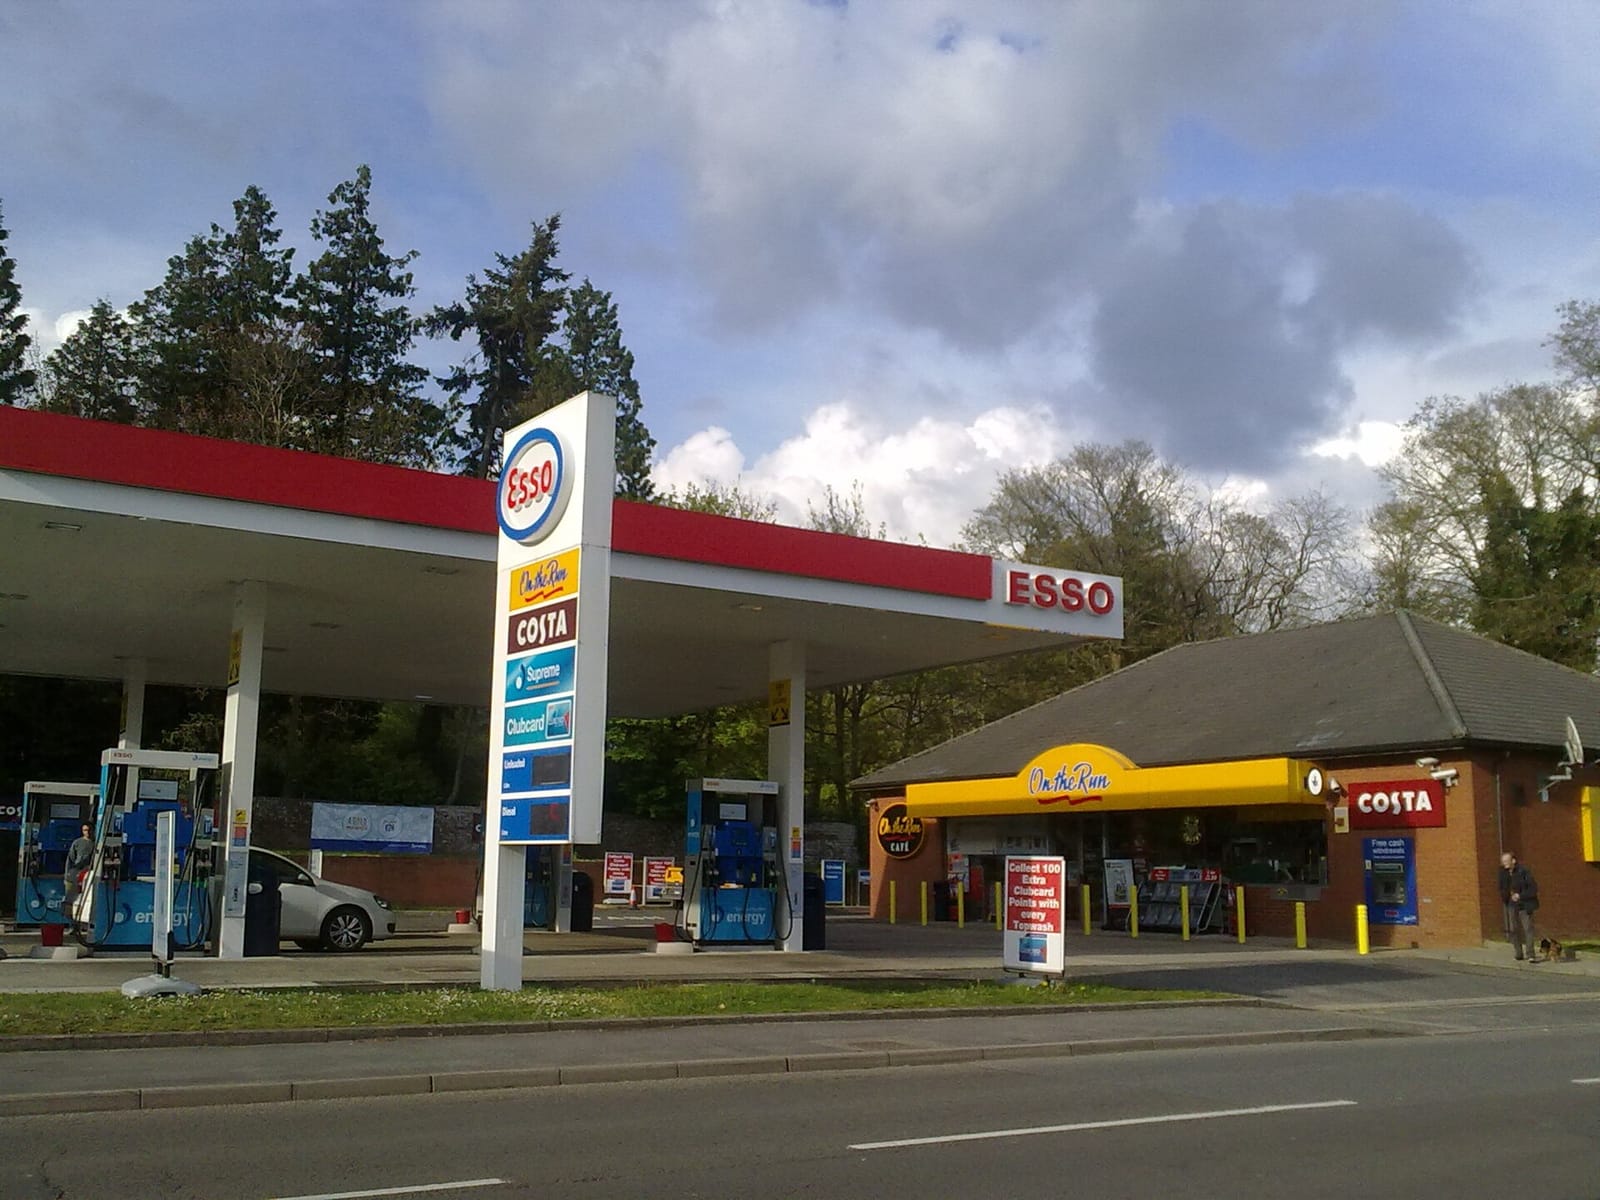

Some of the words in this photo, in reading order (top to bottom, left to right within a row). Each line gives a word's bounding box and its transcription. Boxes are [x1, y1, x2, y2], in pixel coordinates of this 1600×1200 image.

[1008, 570, 1114, 616] ESSO
[516, 609, 568, 646] COSTA
[527, 663, 560, 683] Supreme
[507, 714, 545, 736] Clubcard
[1358, 790, 1432, 815] COSTA
[0, 805, 22, 817] COS
[1009, 863, 1041, 873] Collect
[1043, 864, 1061, 874] 100
[1022, 875, 1046, 885] Extra
[1013, 886, 1054, 897] Clubcard
[1009, 897, 1037, 908] Points
[1038, 899, 1060, 909] with
[135, 910, 193, 927] engy
[1021, 911, 1046, 922] every
